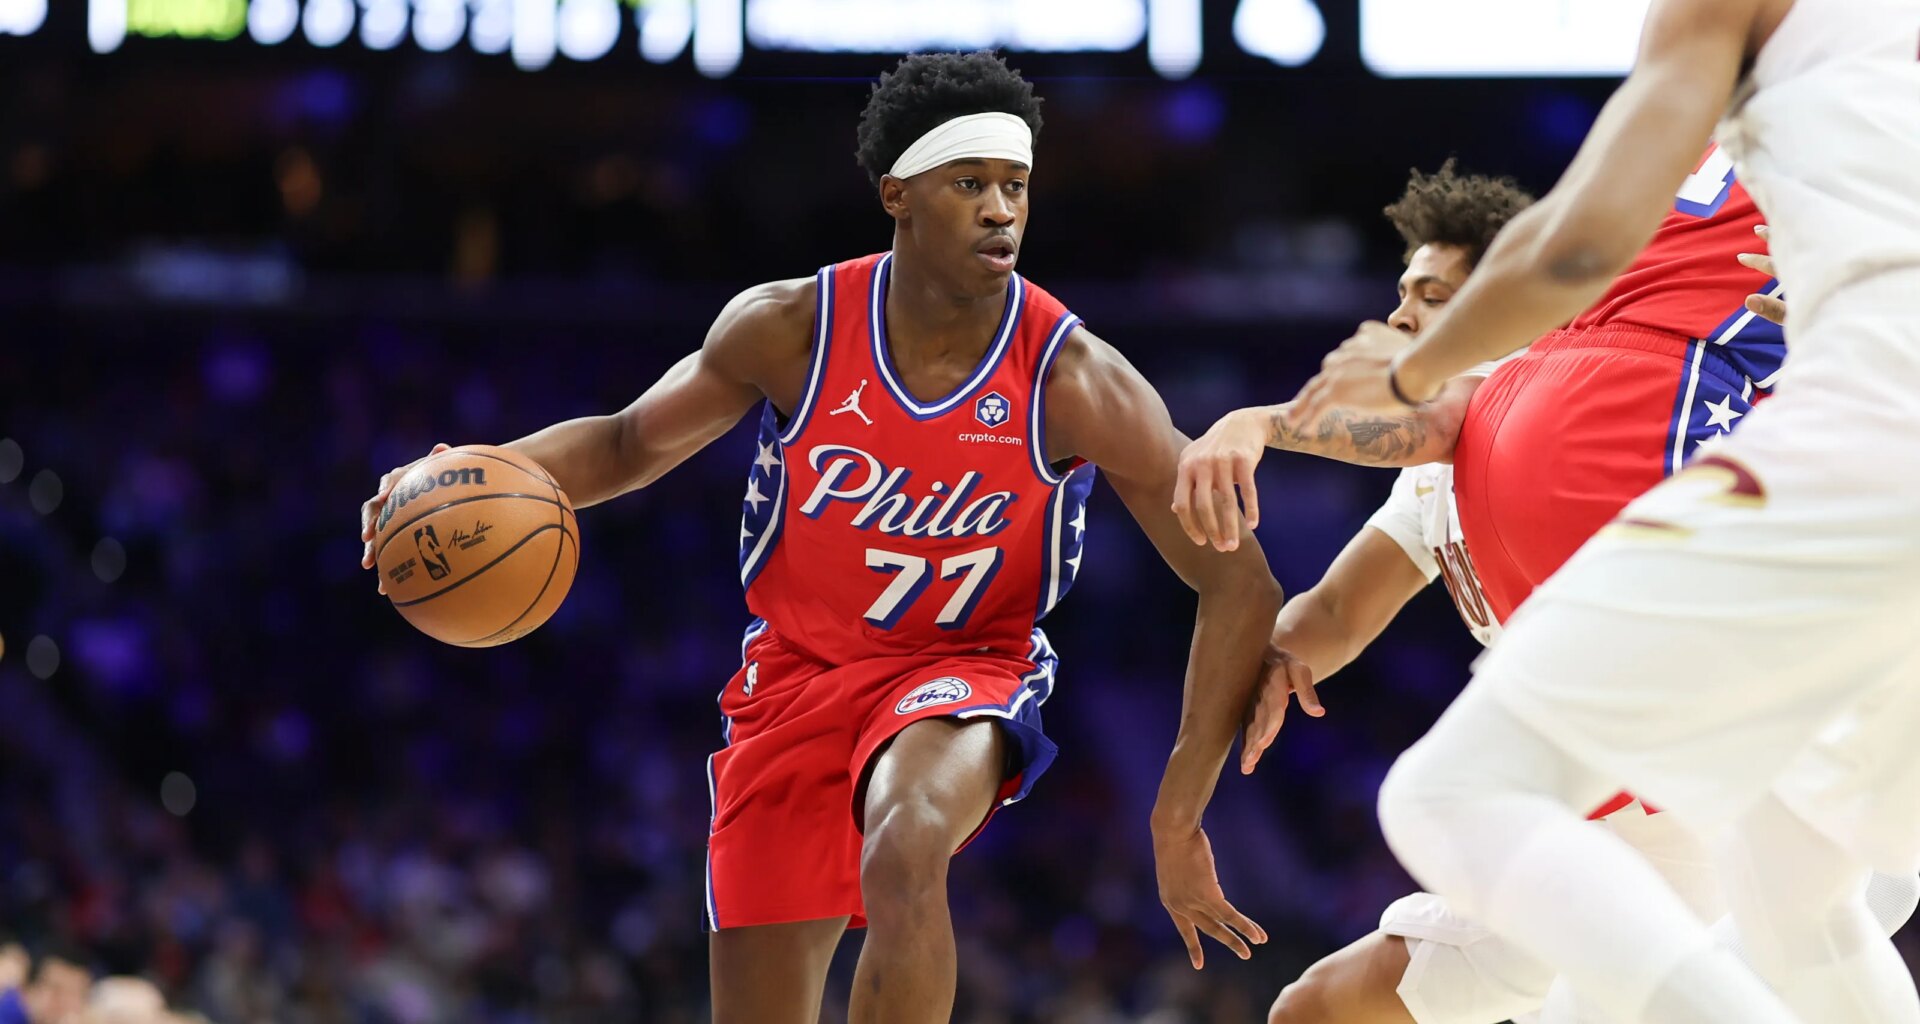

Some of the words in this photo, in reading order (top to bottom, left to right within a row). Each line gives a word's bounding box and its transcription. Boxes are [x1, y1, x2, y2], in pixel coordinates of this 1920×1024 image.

[958, 432, 1022, 446] crypto.com
[799, 444, 1016, 539] Phila
[863, 546, 1001, 628] 77
